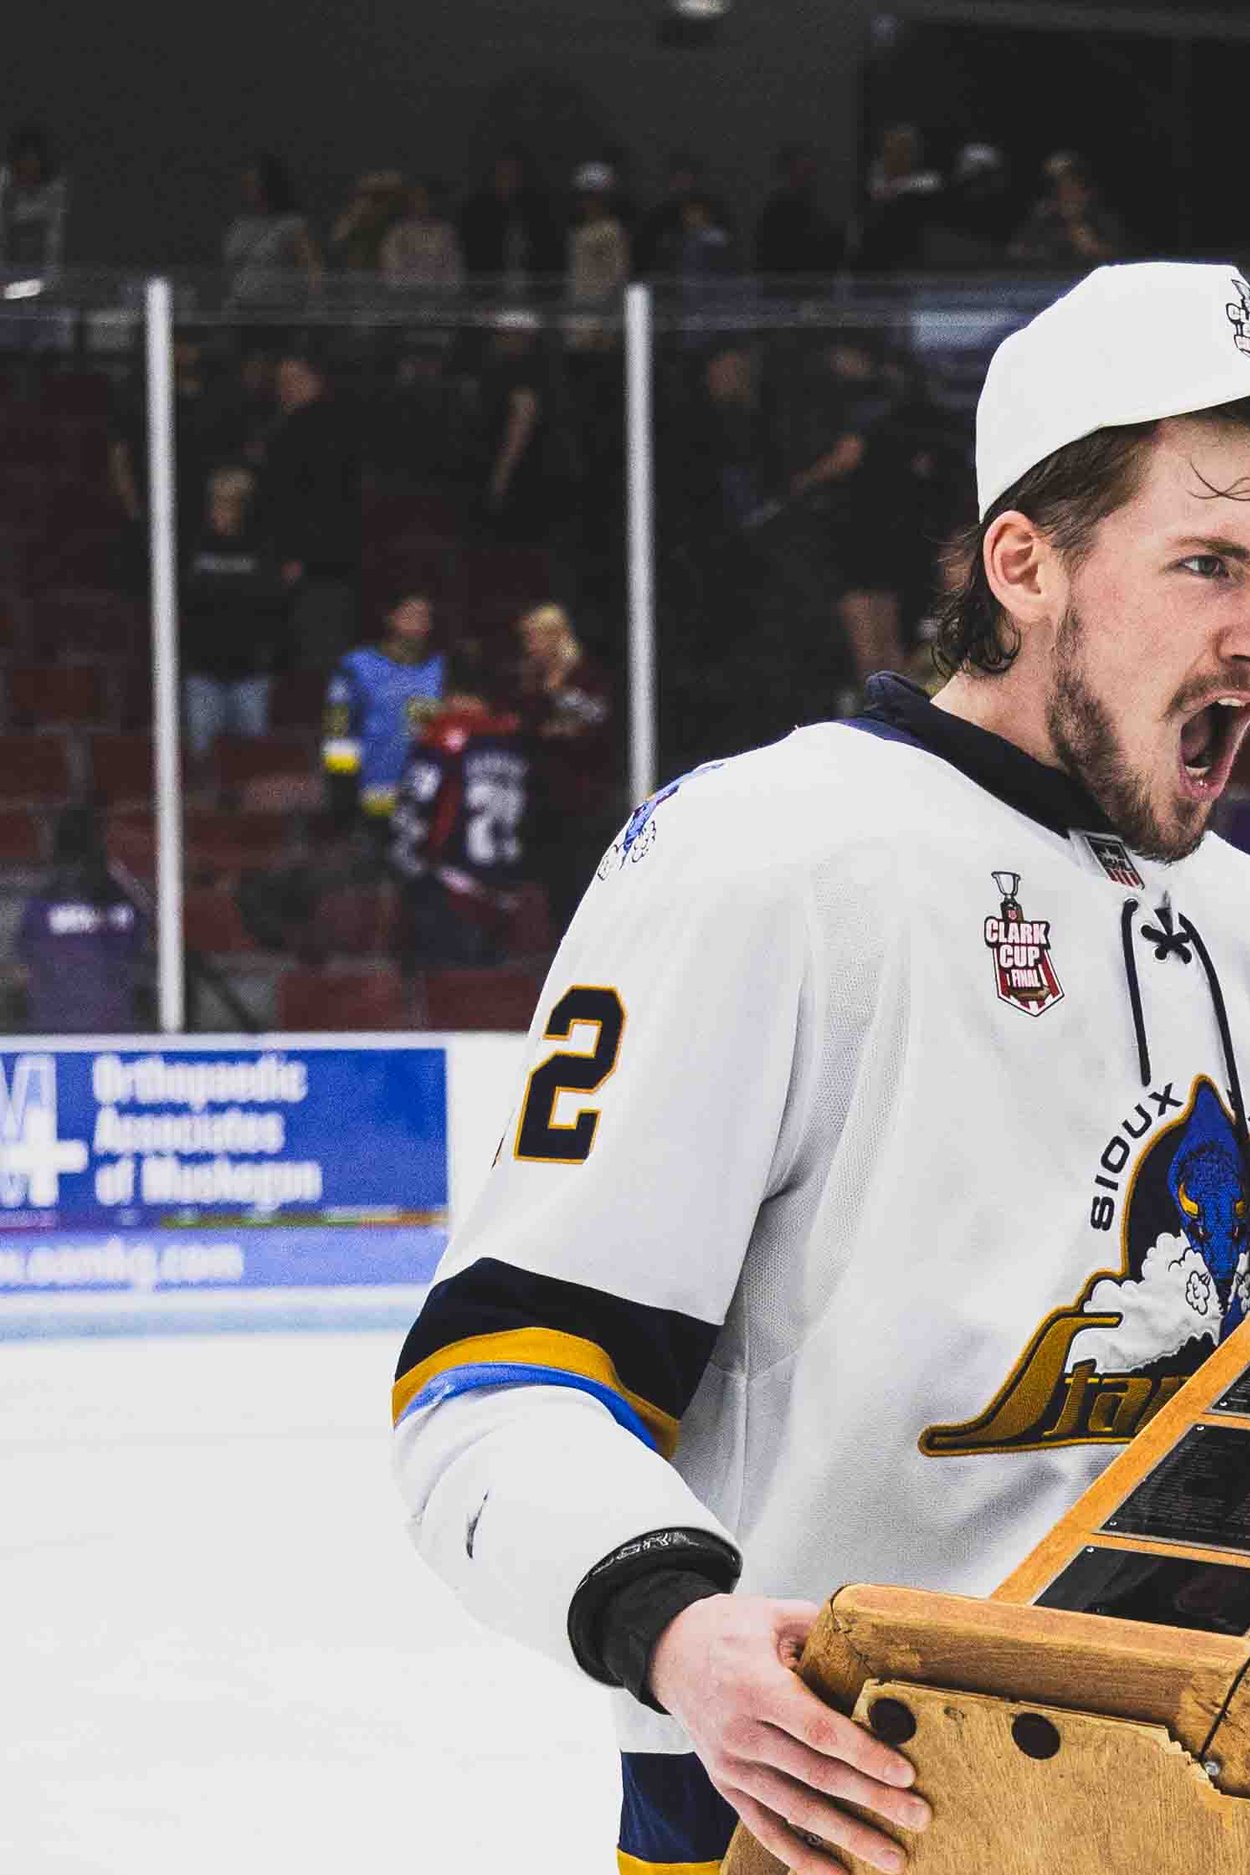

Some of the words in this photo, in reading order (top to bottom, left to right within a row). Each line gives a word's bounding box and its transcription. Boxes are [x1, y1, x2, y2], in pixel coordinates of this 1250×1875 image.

[985, 917, 1047, 945] CLARK
[1000, 943, 1041, 968] CUP
[1011, 968, 1042, 989] FINAL
[514, 985, 626, 1165] 2
[94, 1105, 285, 1155] Associates
[1090, 1083, 1183, 1231] SIOUX
[95, 1154, 135, 1205] of
[142, 1154, 323, 1212] Muskegon
